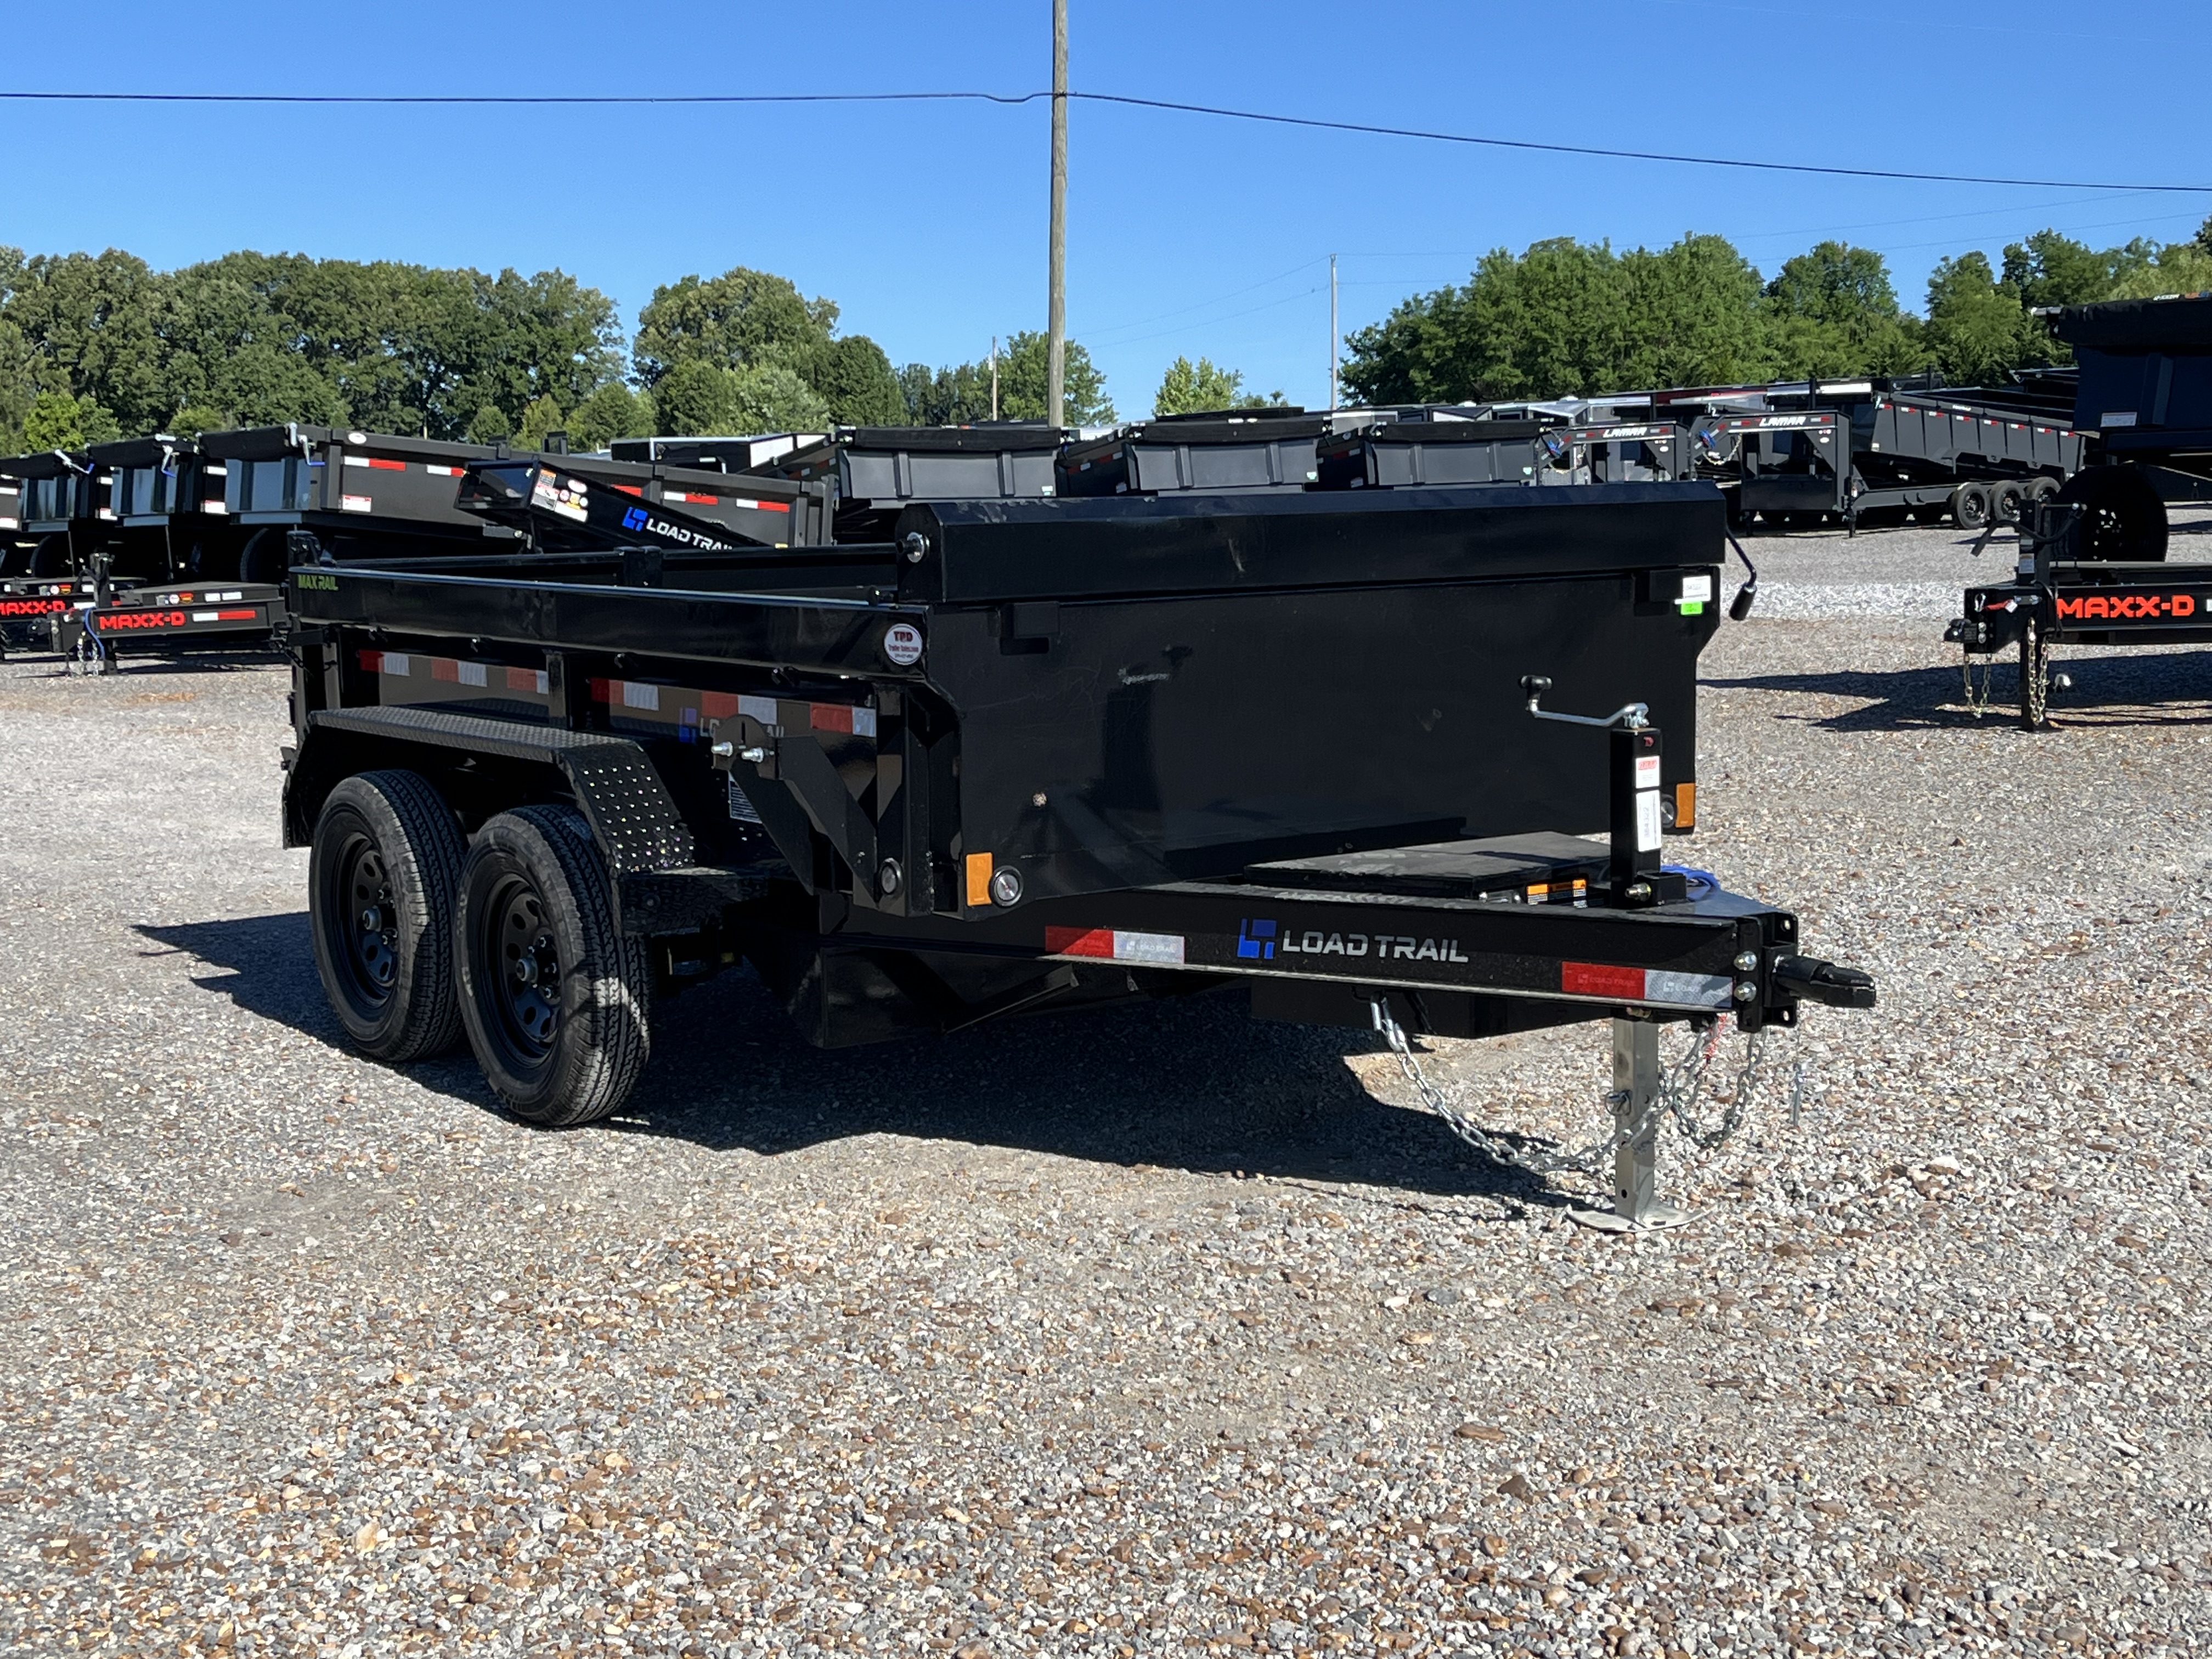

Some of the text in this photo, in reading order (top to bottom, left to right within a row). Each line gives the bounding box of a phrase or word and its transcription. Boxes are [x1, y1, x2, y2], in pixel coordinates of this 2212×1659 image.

[1759, 416, 1806, 427] LAMAR
[646, 518, 691, 542] LOAD
[2057, 595, 2194, 619] MAXX-D
[99, 611, 185, 629] MAXX-D
[1282, 930, 1469, 962] LOAD TRAIL
